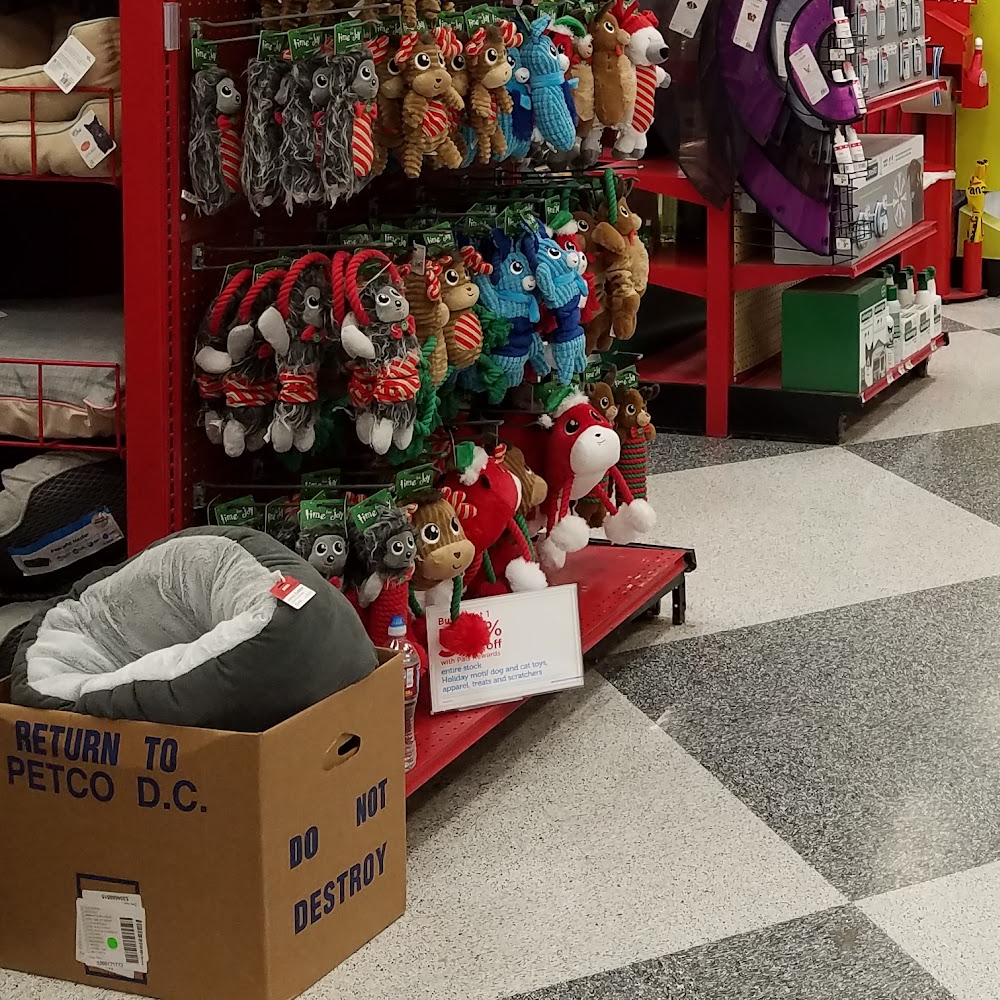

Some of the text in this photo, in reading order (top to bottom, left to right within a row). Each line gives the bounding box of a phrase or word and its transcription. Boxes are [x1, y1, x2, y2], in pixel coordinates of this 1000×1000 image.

[400, 479, 417, 489] time
[220, 514, 239, 525] time
[305, 509, 326, 520] time
[357, 509, 377, 524] time
[438, 617, 452, 626] Bu
[486, 639, 502, 650] off
[441, 657, 456, 666] with
[472, 651, 501, 661] ewards
[441, 663, 482, 675] entire stock
[441, 672, 469, 684] Holiday
[490, 667, 504, 677] dog
[505, 664, 519, 673] and
[520, 662, 531, 670] cat
[442, 669, 543, 693] apparel, treats and scratchers
[15, 720, 178, 773] RETURN TO
[6, 756, 208, 813] PETCO D.C.
[289, 778, 388, 870] DO NOT
[294, 842, 388, 936] DESTROY
